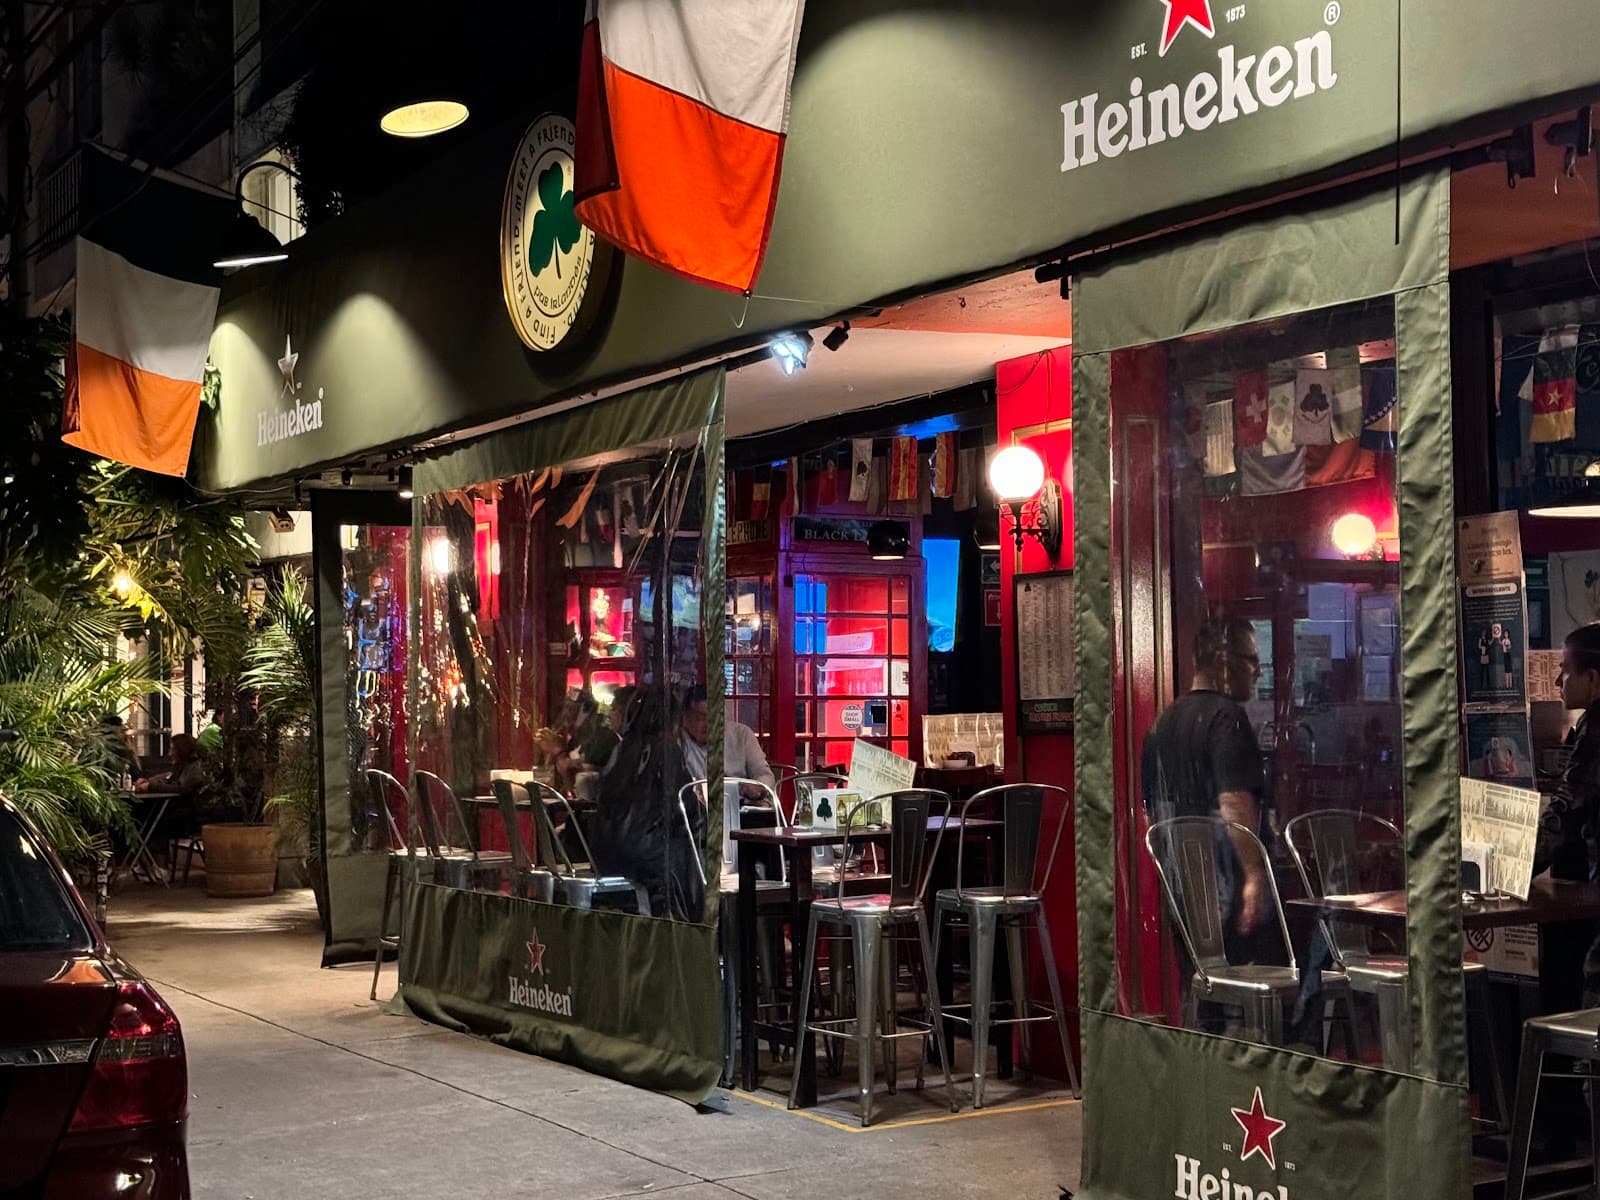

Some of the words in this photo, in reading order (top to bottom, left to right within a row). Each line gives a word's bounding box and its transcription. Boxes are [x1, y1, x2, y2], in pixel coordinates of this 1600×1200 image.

[1131, 43, 1147, 59] EST.
[1225, 4, 1245, 23] 1873
[1060, 30, 1338, 173] Heineken
[257, 398, 323, 447] Heineken
[804, 528, 849, 541] BLACK
[508, 976, 572, 1017] Heineken
